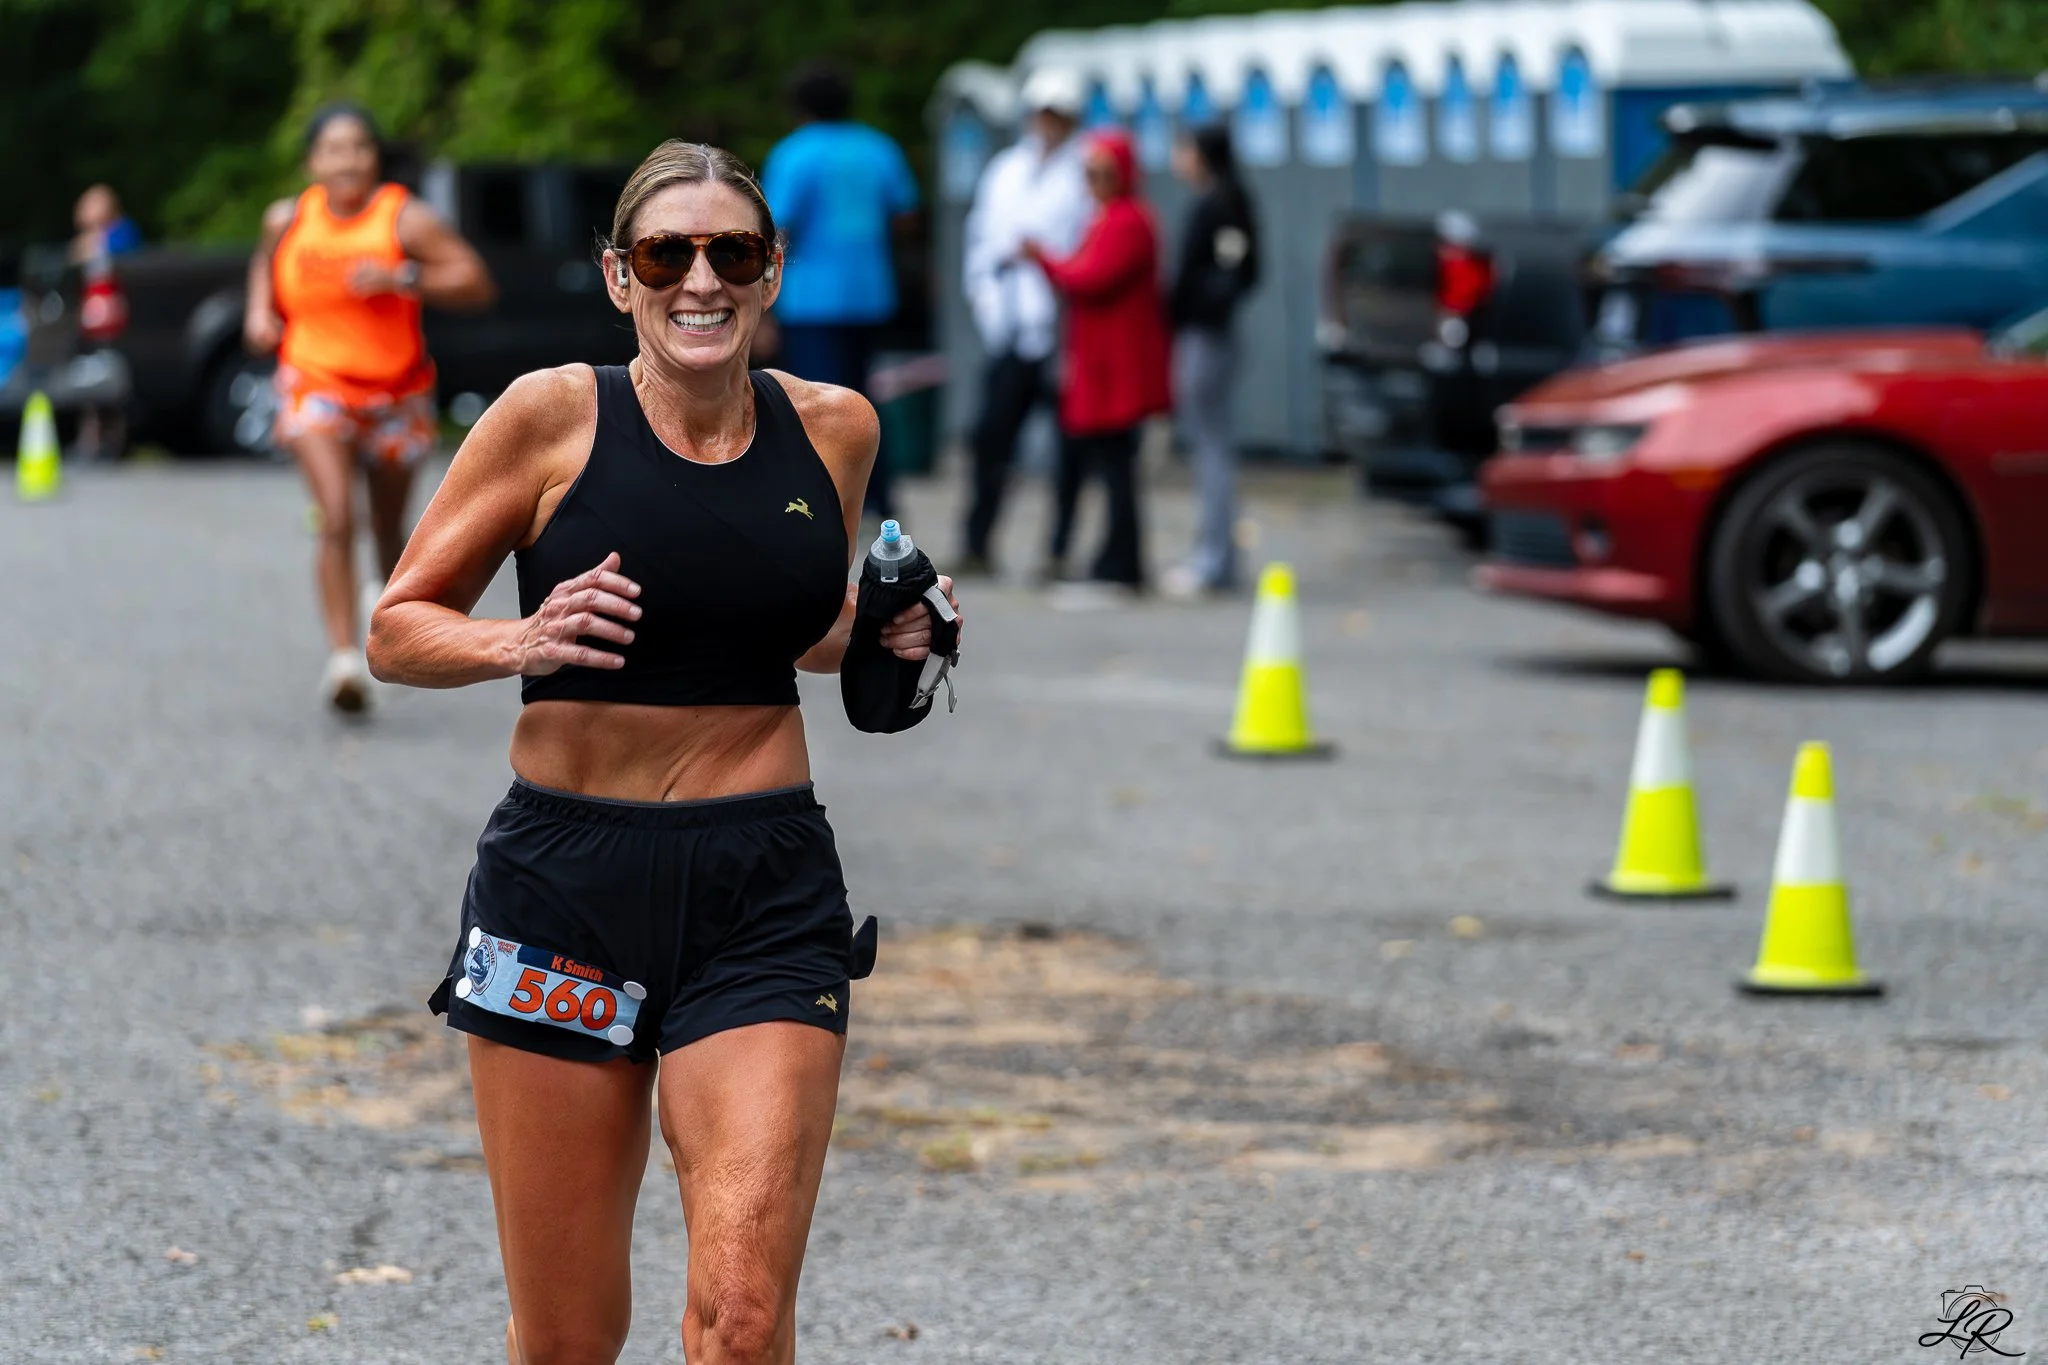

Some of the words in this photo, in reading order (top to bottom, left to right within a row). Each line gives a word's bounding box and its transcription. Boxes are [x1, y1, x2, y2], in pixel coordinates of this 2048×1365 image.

[551, 955, 564, 971] K
[563, 959, 604, 983] Smith
[508, 967, 618, 1031] 560
